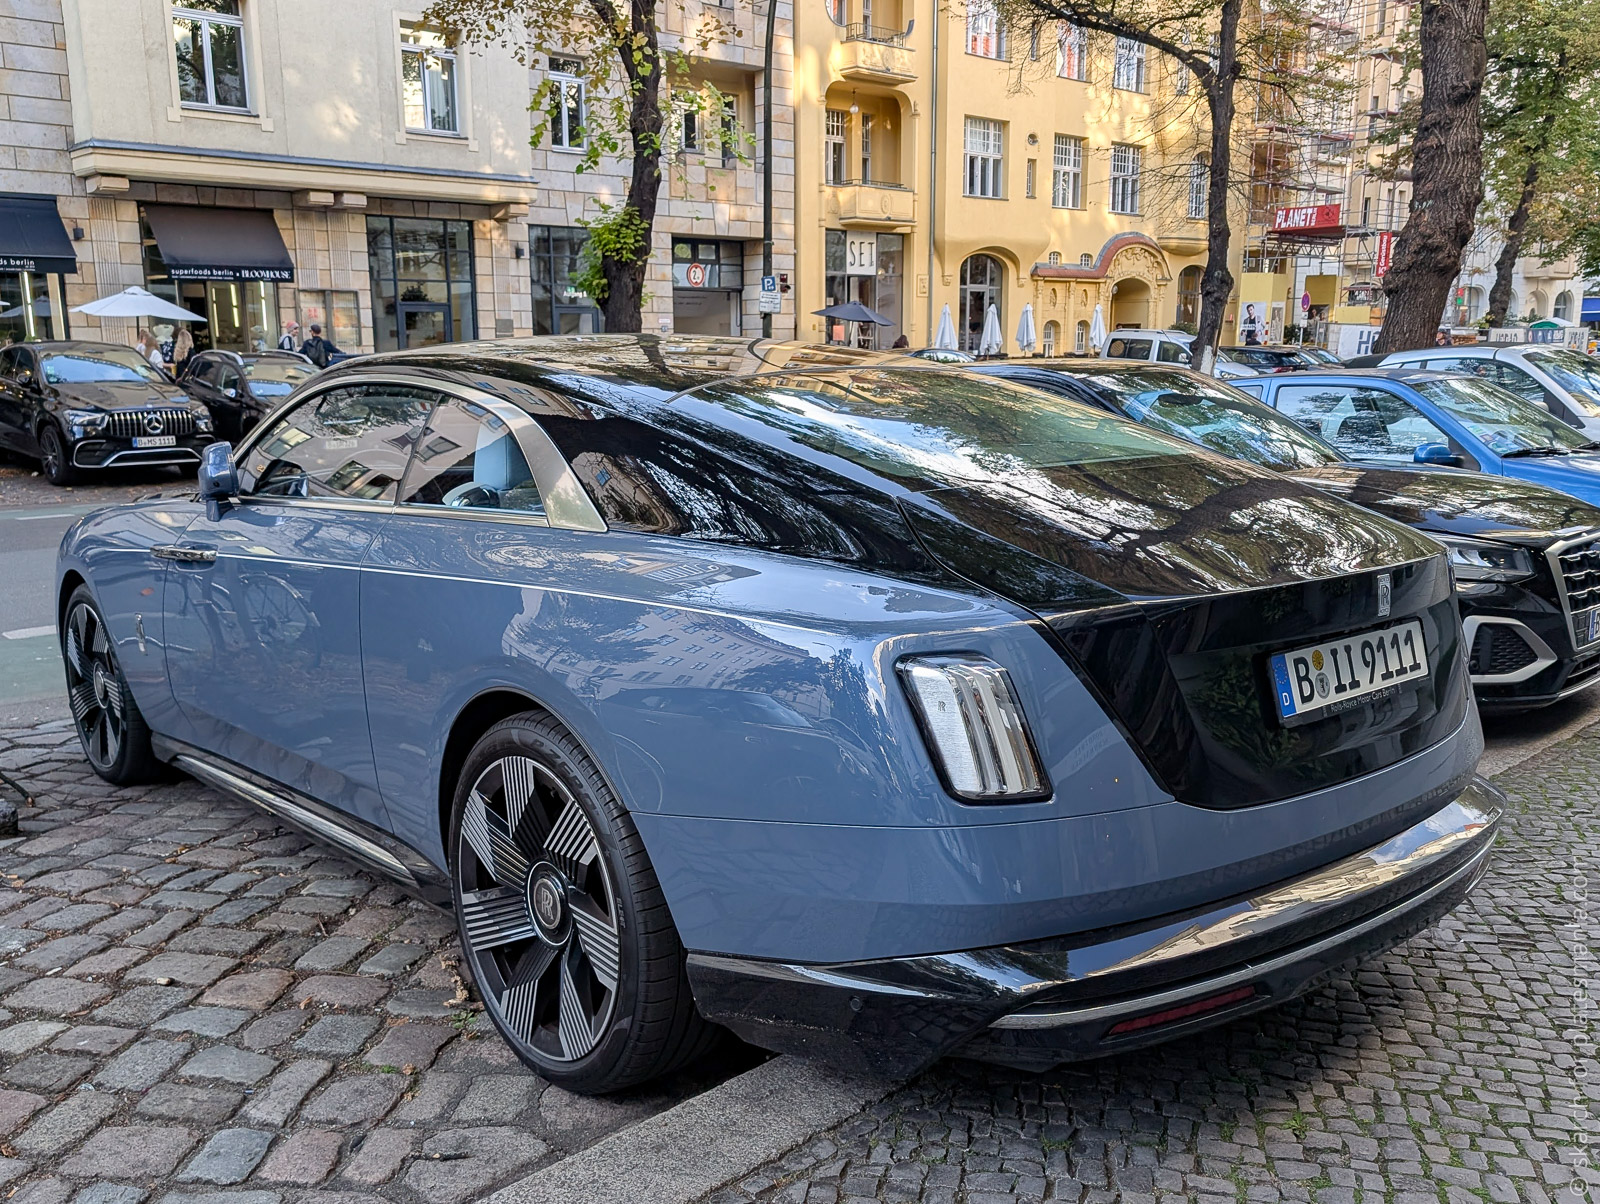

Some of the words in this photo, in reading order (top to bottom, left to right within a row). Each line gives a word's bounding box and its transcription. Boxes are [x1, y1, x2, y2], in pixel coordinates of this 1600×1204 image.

[1275, 207, 1313, 229] PLANET
[10, 258, 35, 266] berlin
[849, 240, 875, 267] SET
[171, 267, 211, 276] superfoods
[212, 268, 234, 276] berlin
[241, 269, 291, 279] BLOOMHOUSE
[764, 278, 773, 290] P
[1293, 656, 1315, 704] B
[1330, 644, 1361, 694] II
[1361, 629, 1421, 685] 9111
[1282, 692, 1290, 706] D
[1330, 699, 1357, 712] Rolls-Royce
[1356, 694, 1371, 704] Motor
[1371, 690, 1382, 700] Cars
[1382, 687, 1396, 697] Berlin
